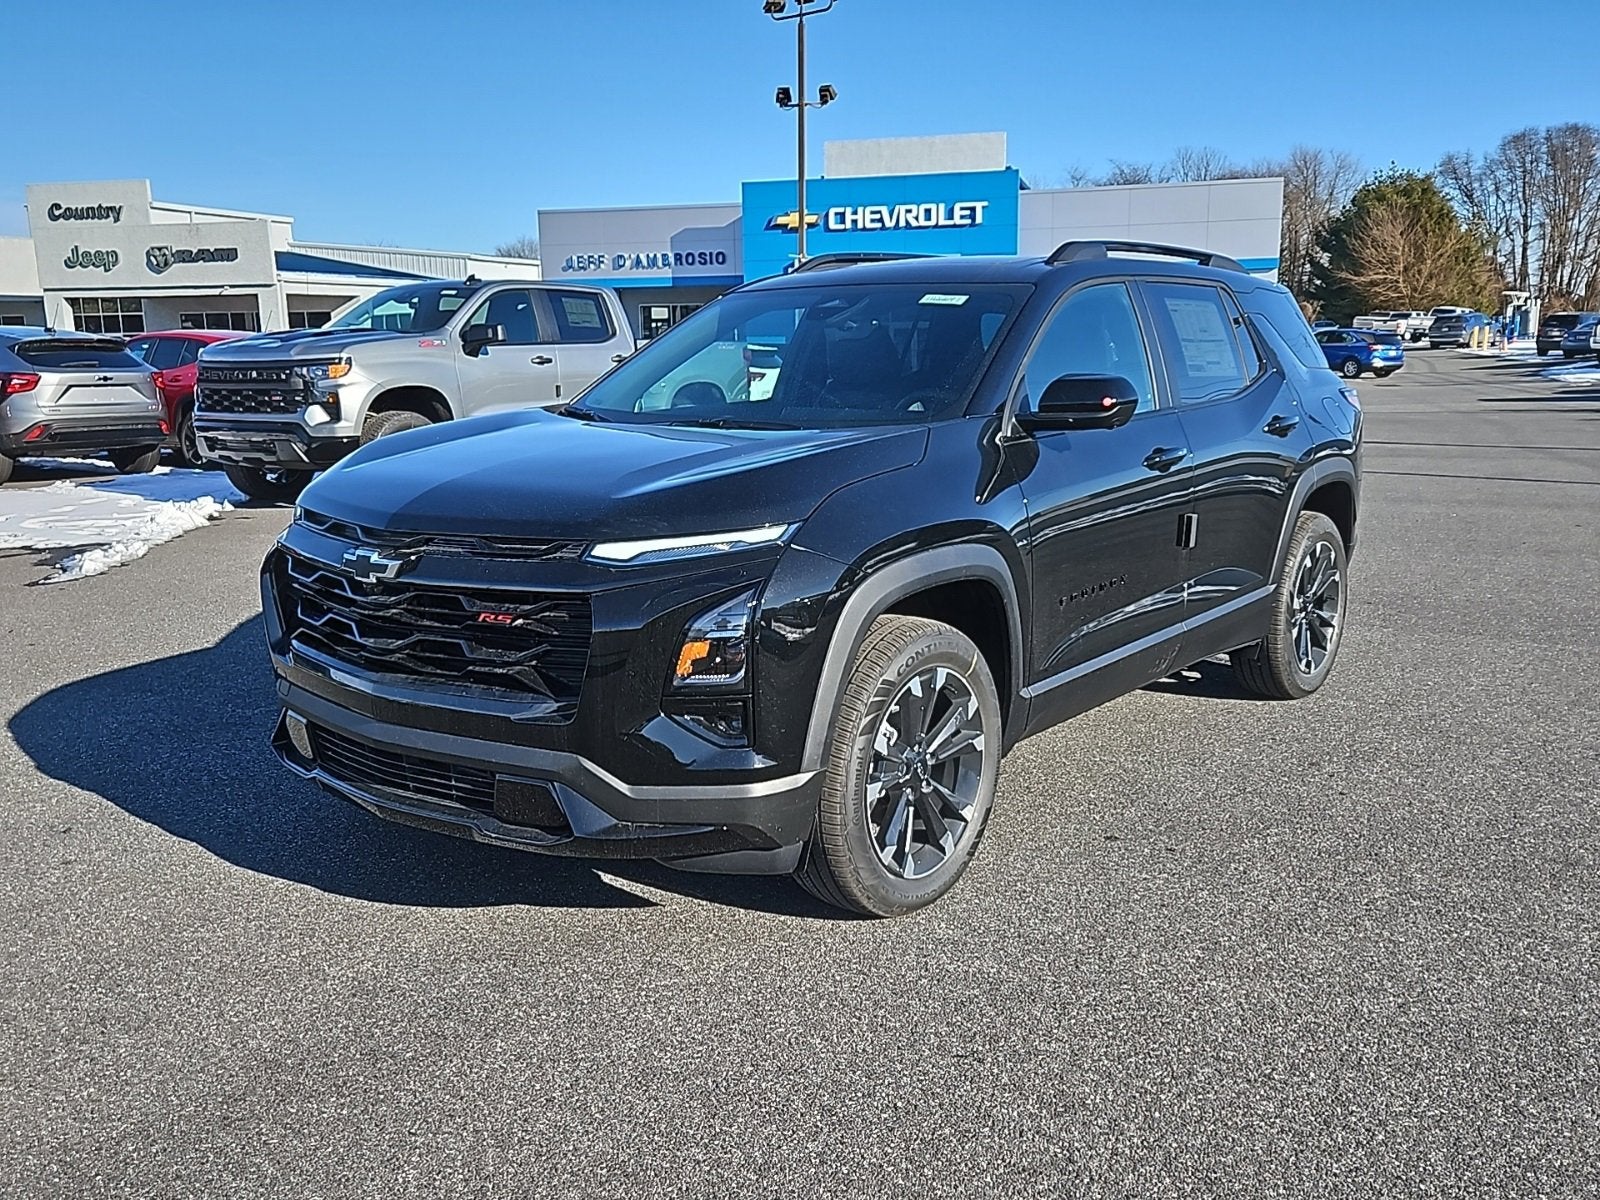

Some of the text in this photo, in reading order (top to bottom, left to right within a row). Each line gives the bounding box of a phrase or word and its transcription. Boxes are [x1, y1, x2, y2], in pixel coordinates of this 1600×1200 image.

[48, 202, 123, 223] Country
[827, 200, 989, 231] CHEVROLET
[64, 245, 119, 272] Jeep
[172, 247, 239, 263] RAM
[562, 251, 727, 271] JEFF D'AMBROSIO
[477, 612, 513, 624] RS
